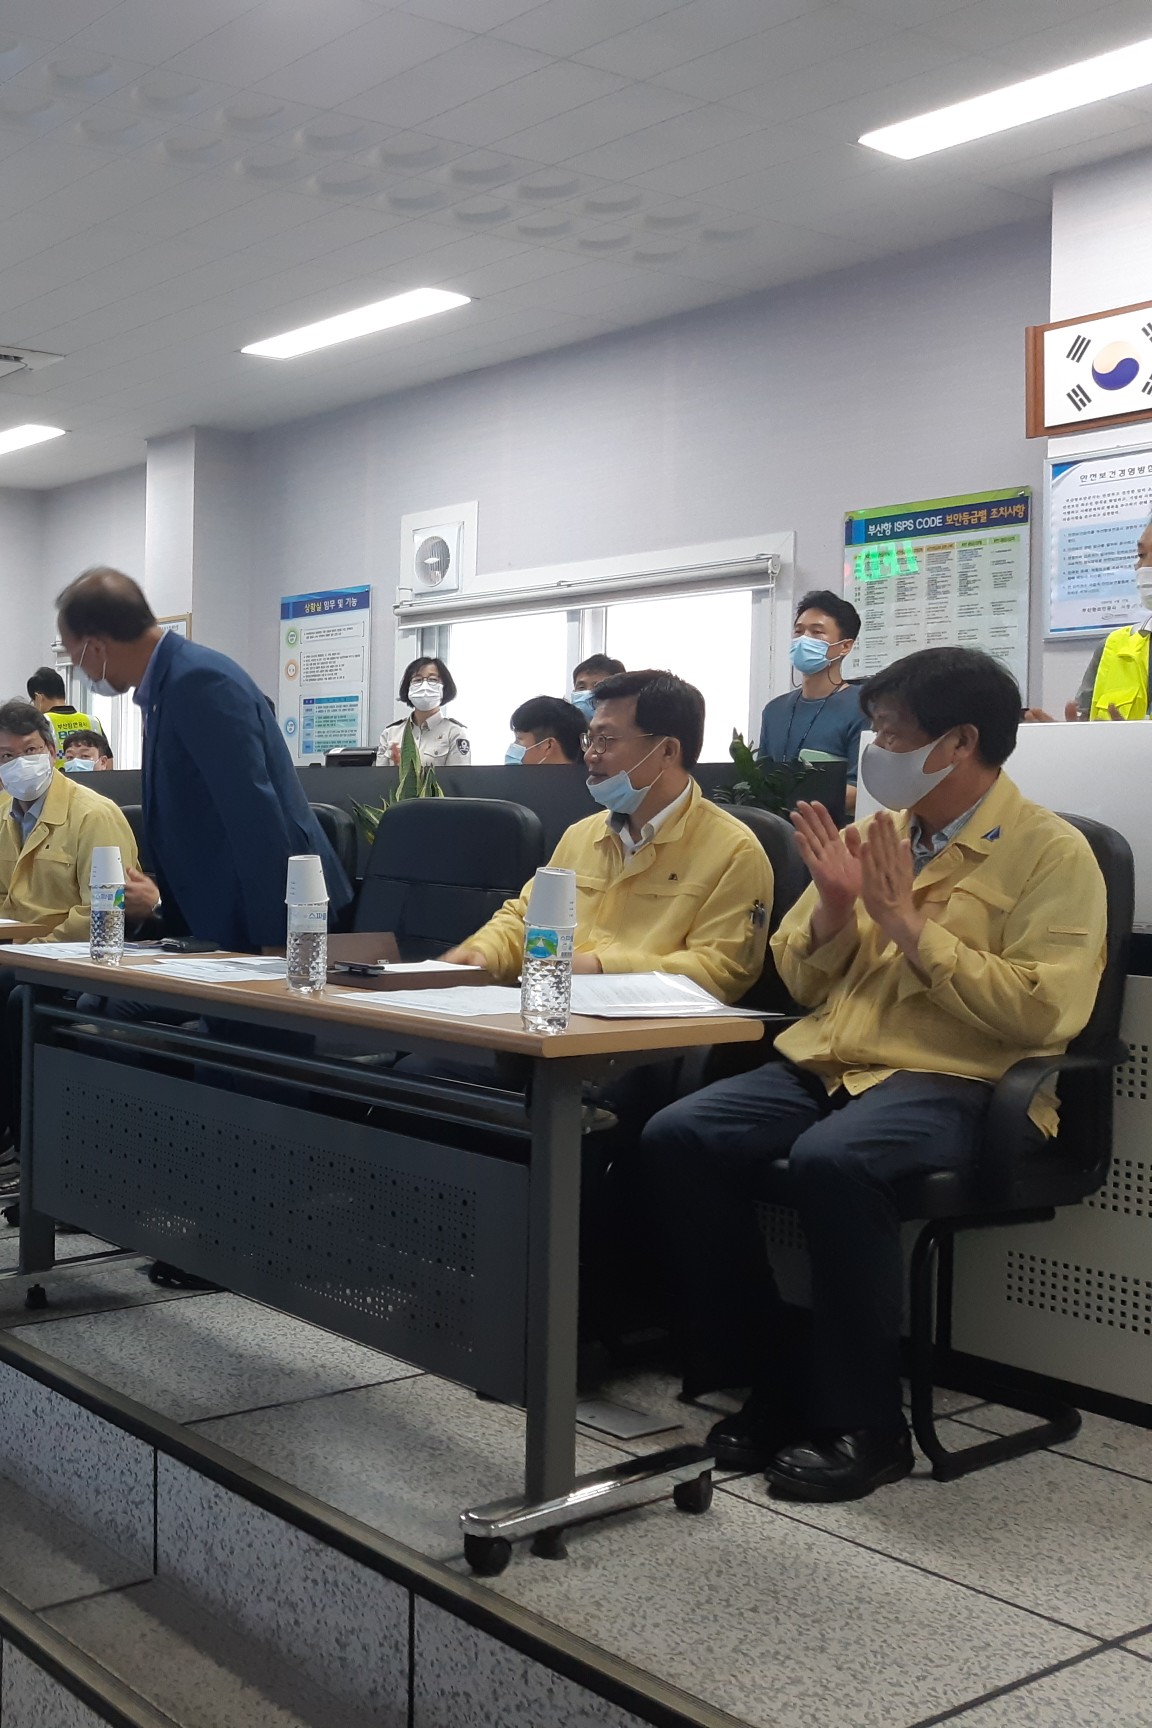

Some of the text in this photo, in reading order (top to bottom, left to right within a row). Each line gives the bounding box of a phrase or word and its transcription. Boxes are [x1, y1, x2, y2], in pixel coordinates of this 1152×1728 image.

[867, 504, 1026, 537] 부산항 ISPS CODE 보안등급별 조치사항
[304, 601, 322, 613] 상황실
[345, 597, 358, 608] 기능
